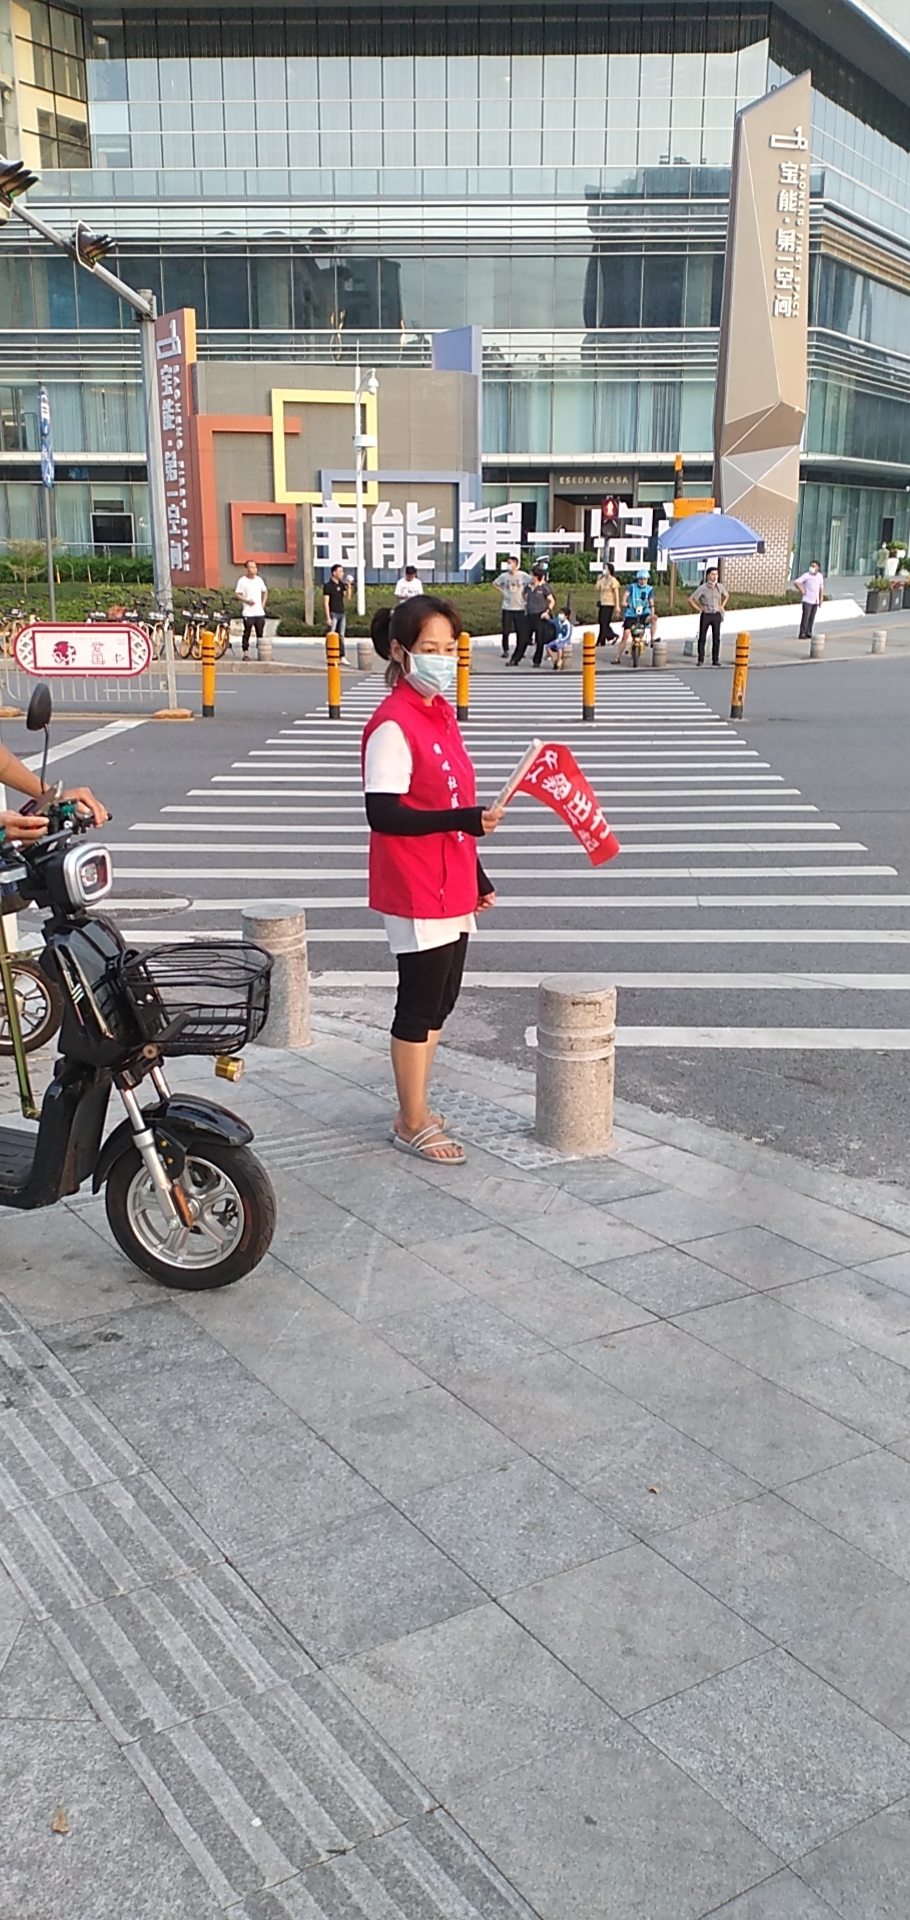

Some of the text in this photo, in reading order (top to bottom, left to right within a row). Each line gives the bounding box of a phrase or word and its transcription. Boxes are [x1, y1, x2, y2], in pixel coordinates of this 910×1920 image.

[773, 160, 799, 318] 宝能·第一空间
[792, 163, 807, 317] BAONENG FIRST SPACE
